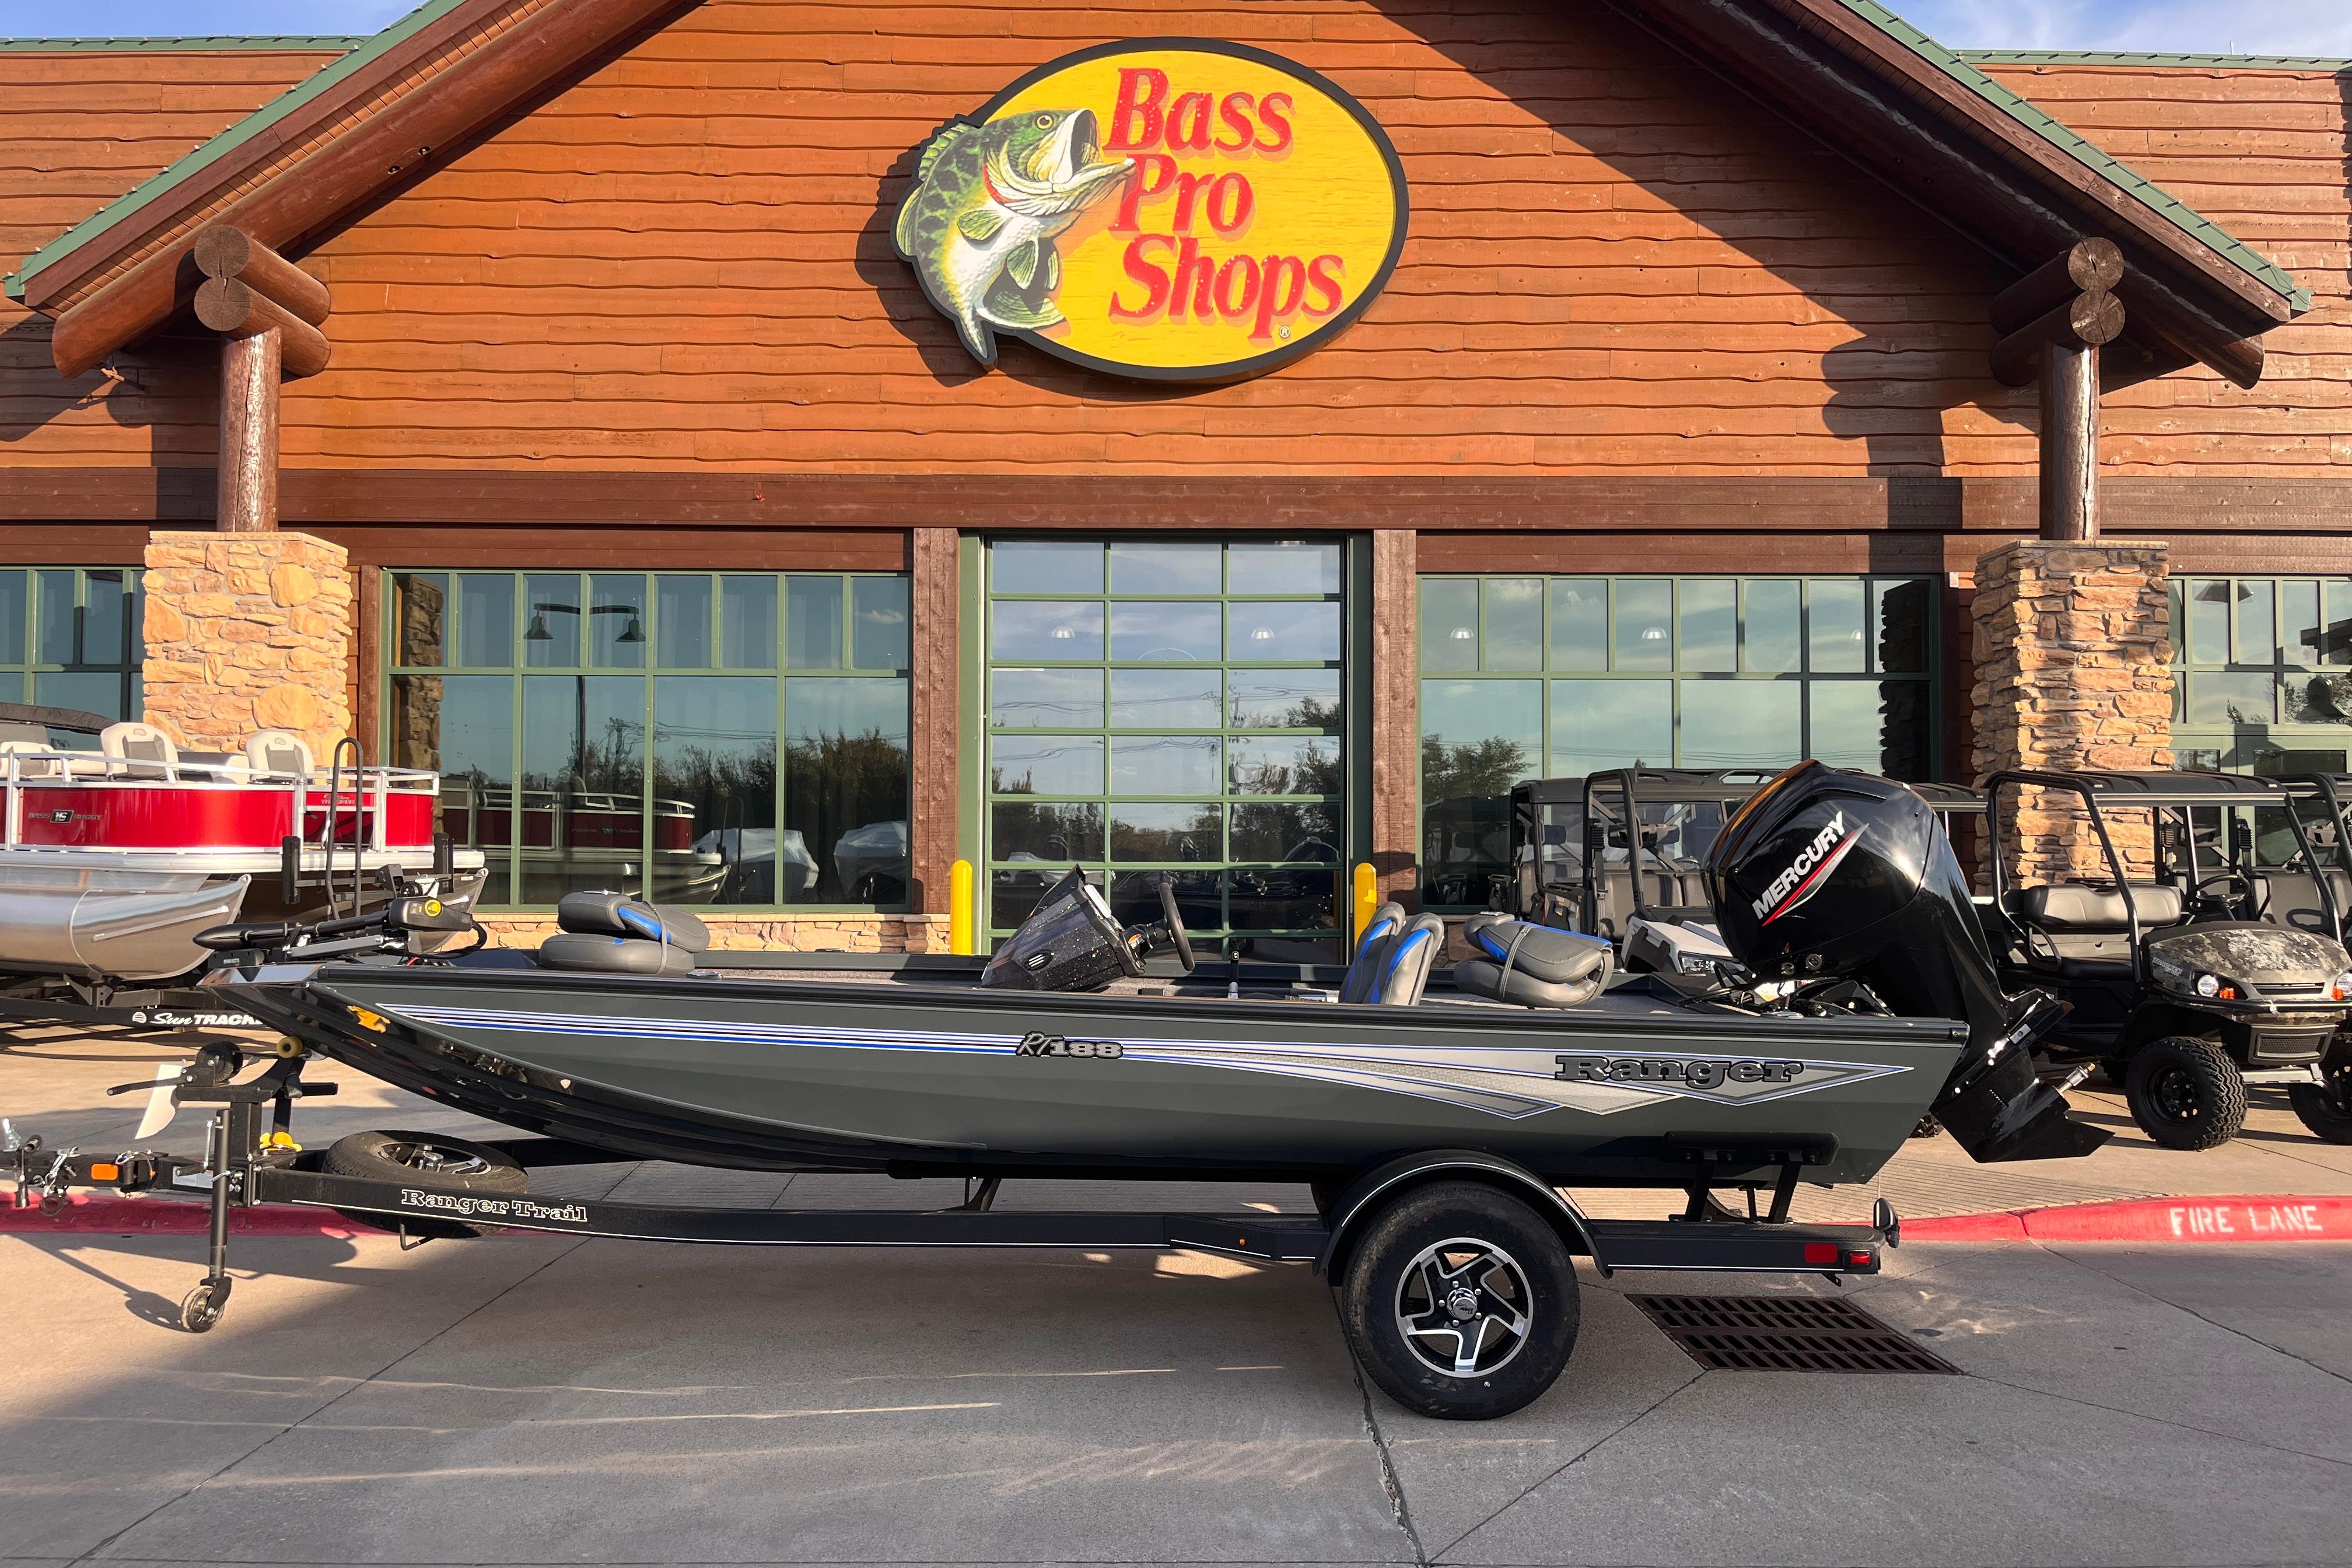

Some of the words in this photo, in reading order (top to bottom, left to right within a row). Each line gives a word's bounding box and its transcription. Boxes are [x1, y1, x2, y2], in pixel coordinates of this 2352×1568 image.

[1102, 67, 1293, 153] Bass
[1108, 153, 1254, 233] Pro
[1108, 233, 1343, 339] Shops
[1752, 811, 1845, 920] MERCURY
[150, 1013, 193, 1025] Sun
[193, 1014, 263, 1026] TRACK
[1554, 1055, 1804, 1090] Ranger
[401, 1188, 509, 1214] Ranger
[511, 1200, 587, 1222] Trail
[2169, 1206, 2235, 1237] FIRE
[2247, 1205, 2323, 1232] LANE
